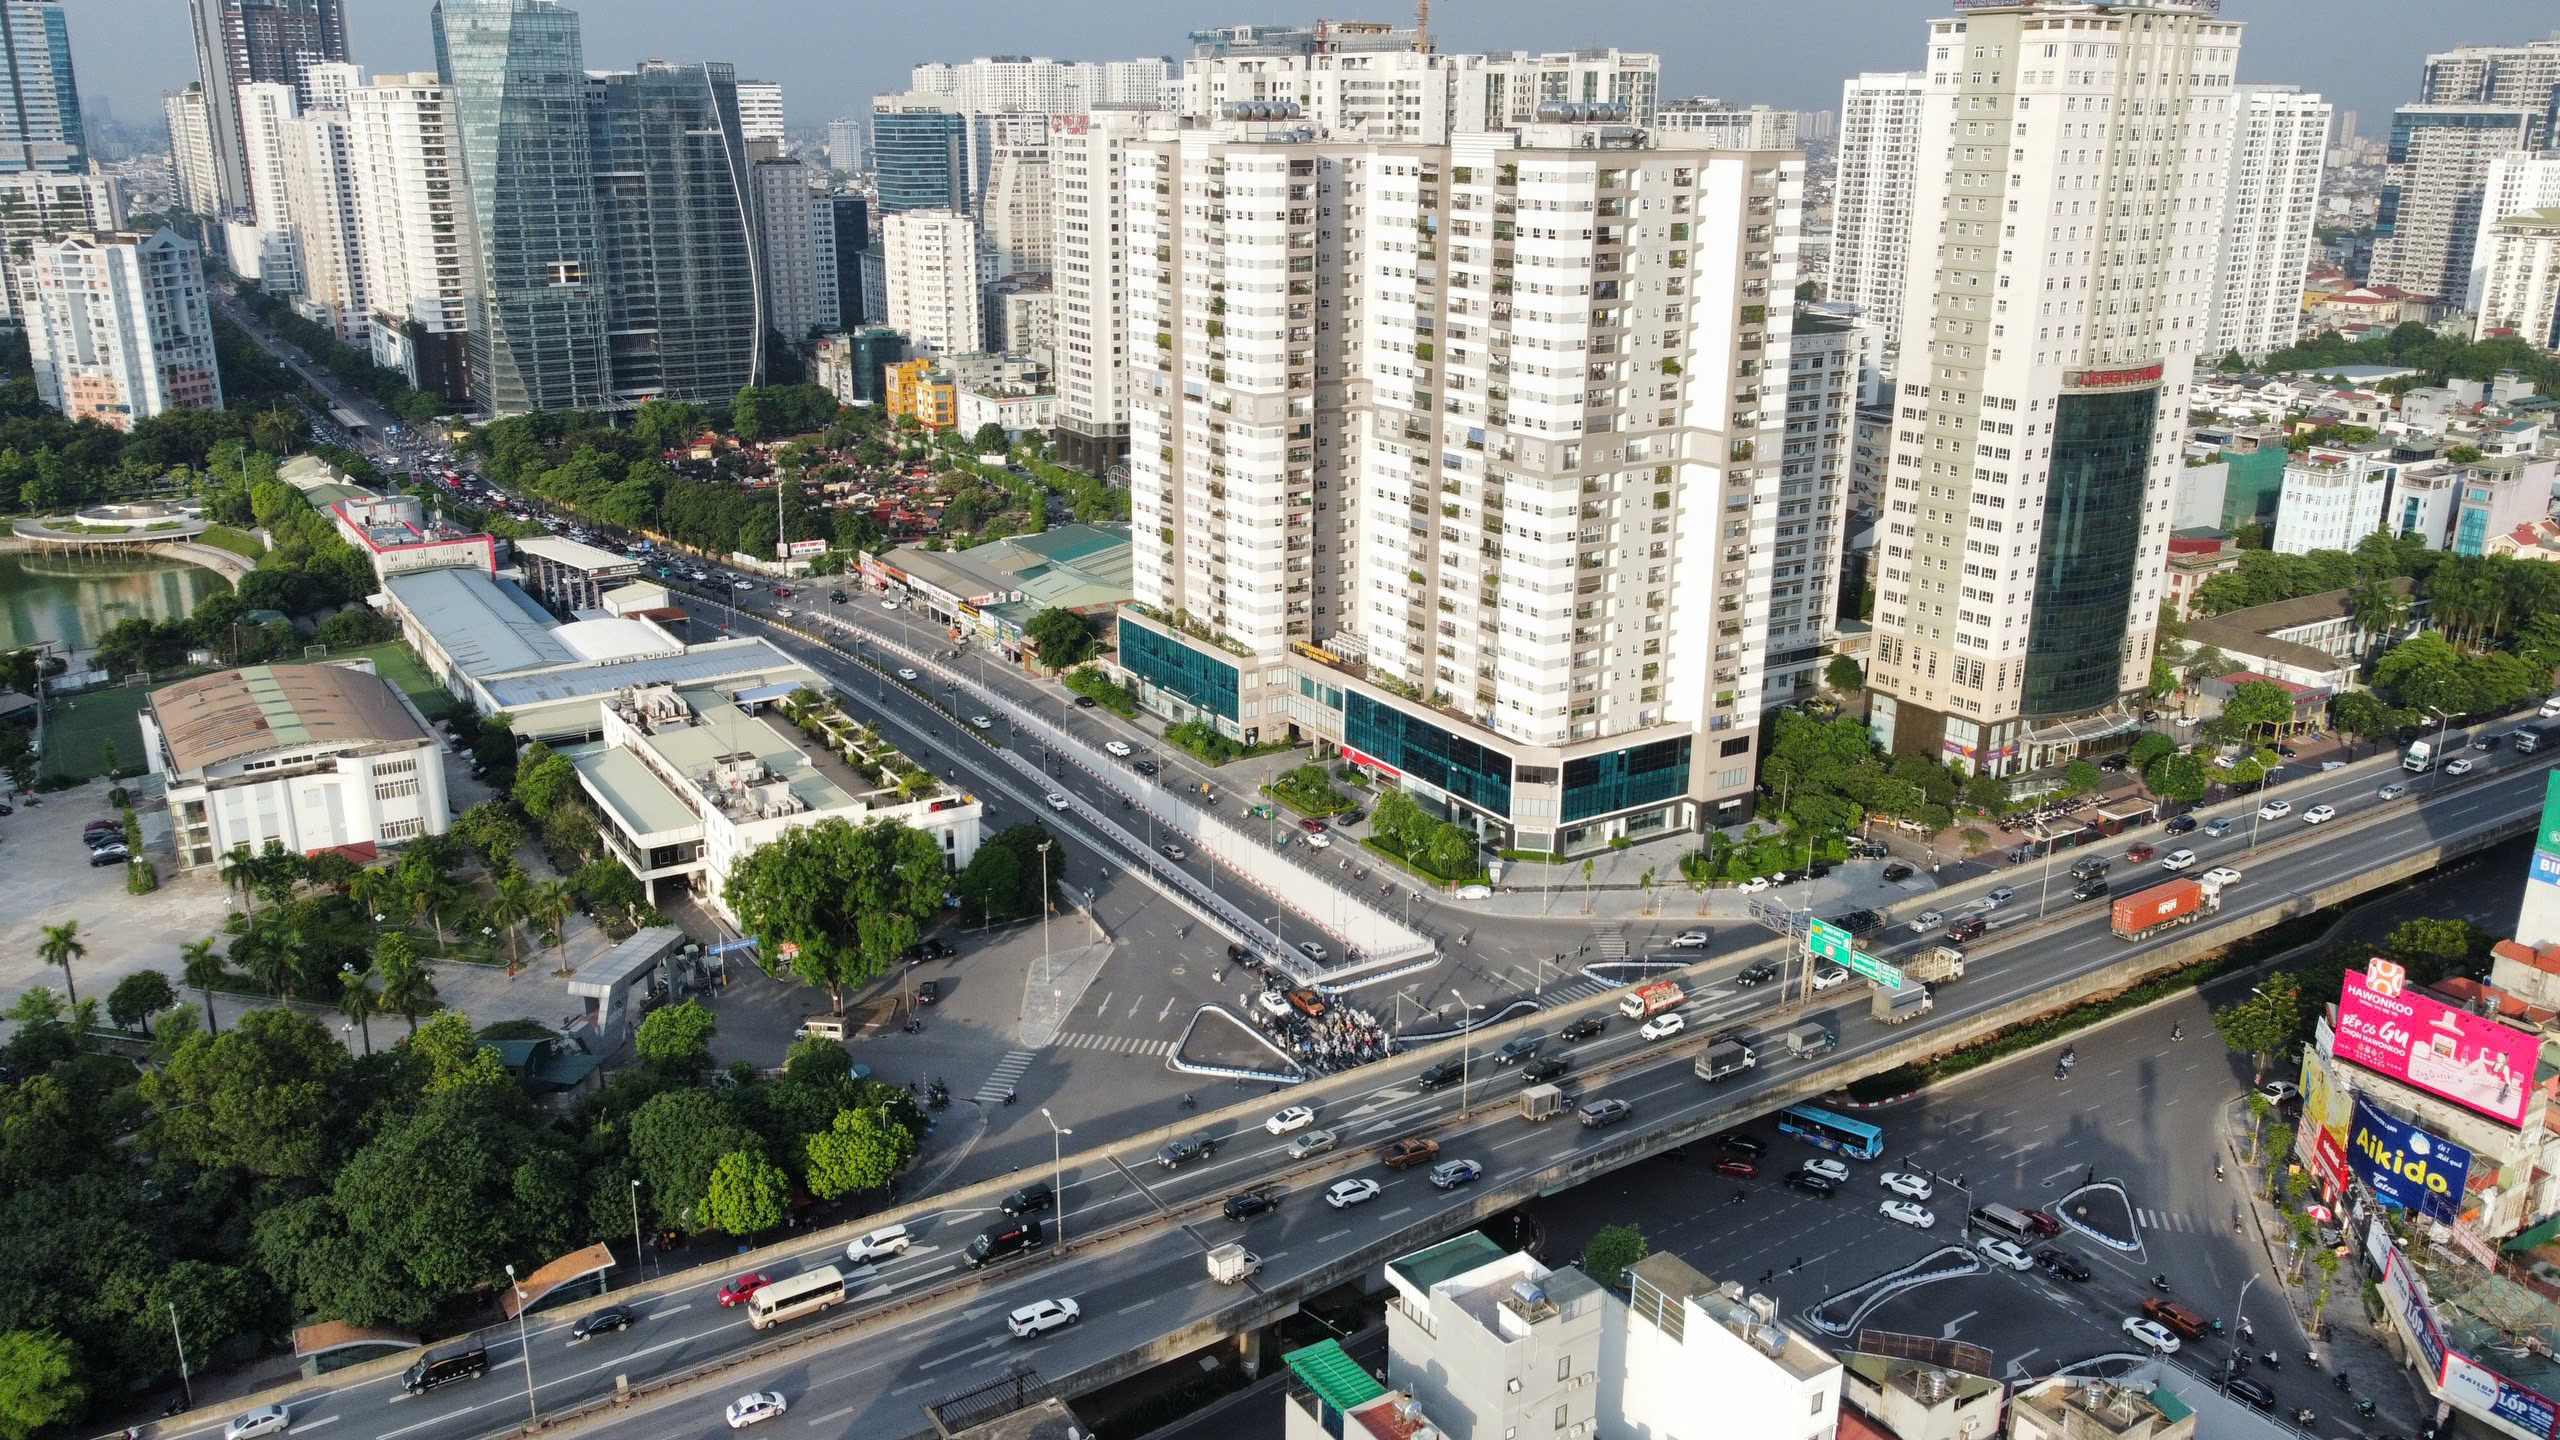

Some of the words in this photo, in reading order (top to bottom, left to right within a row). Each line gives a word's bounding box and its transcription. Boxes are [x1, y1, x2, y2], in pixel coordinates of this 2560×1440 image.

[2347, 984, 2413, 1016] HAWONKOO
[2362, 1034, 2406, 1056] HAWONKOO
[2356, 1127, 2448, 1193] Aikido
[2498, 1391, 2528, 1414] LỐP
